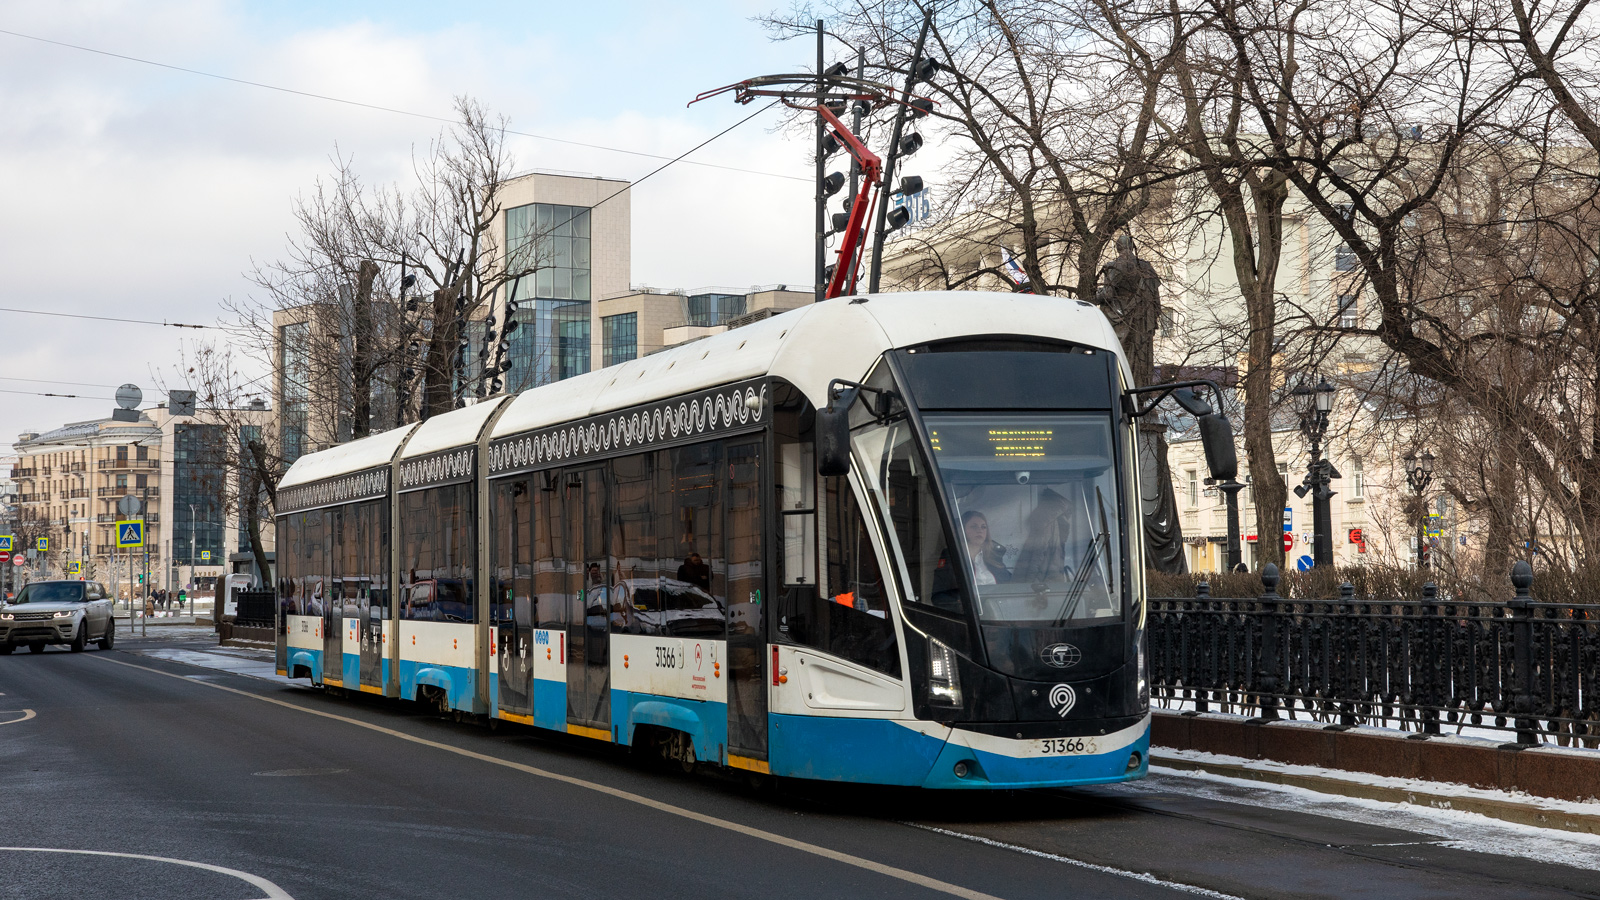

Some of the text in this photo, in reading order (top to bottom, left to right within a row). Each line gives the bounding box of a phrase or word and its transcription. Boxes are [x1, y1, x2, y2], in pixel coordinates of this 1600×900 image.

[905, 187, 930, 226] ВТБ
[655, 646, 676, 669] 31366
[1041, 738, 1084, 753] 31366
